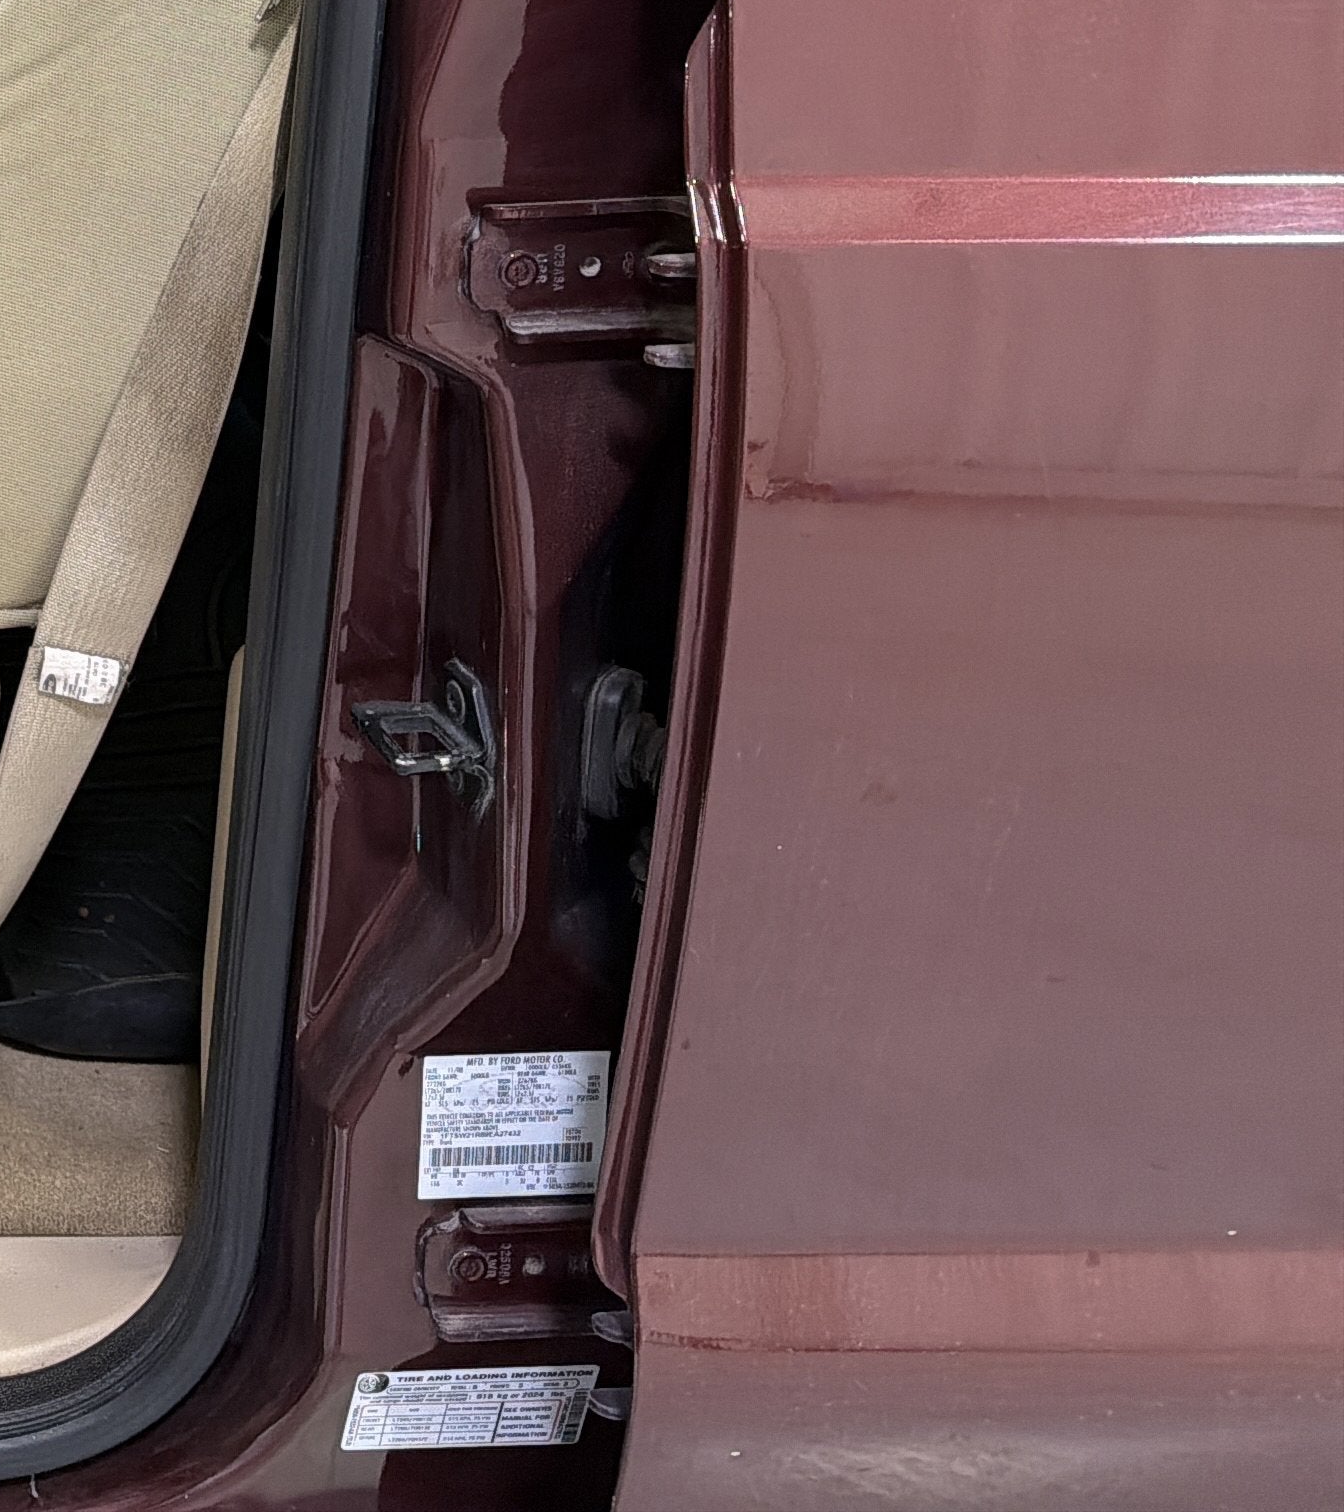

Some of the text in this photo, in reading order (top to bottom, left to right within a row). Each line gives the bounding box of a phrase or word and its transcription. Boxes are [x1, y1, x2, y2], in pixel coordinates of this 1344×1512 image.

[488, 1057, 498, 1065] BY
[500, 1056, 521, 1065] FORD
[523, 1055, 551, 1064] MOTOR
[455, 1372, 507, 1381] LOADING
[511, 1369, 594, 1378] INFORMATION
